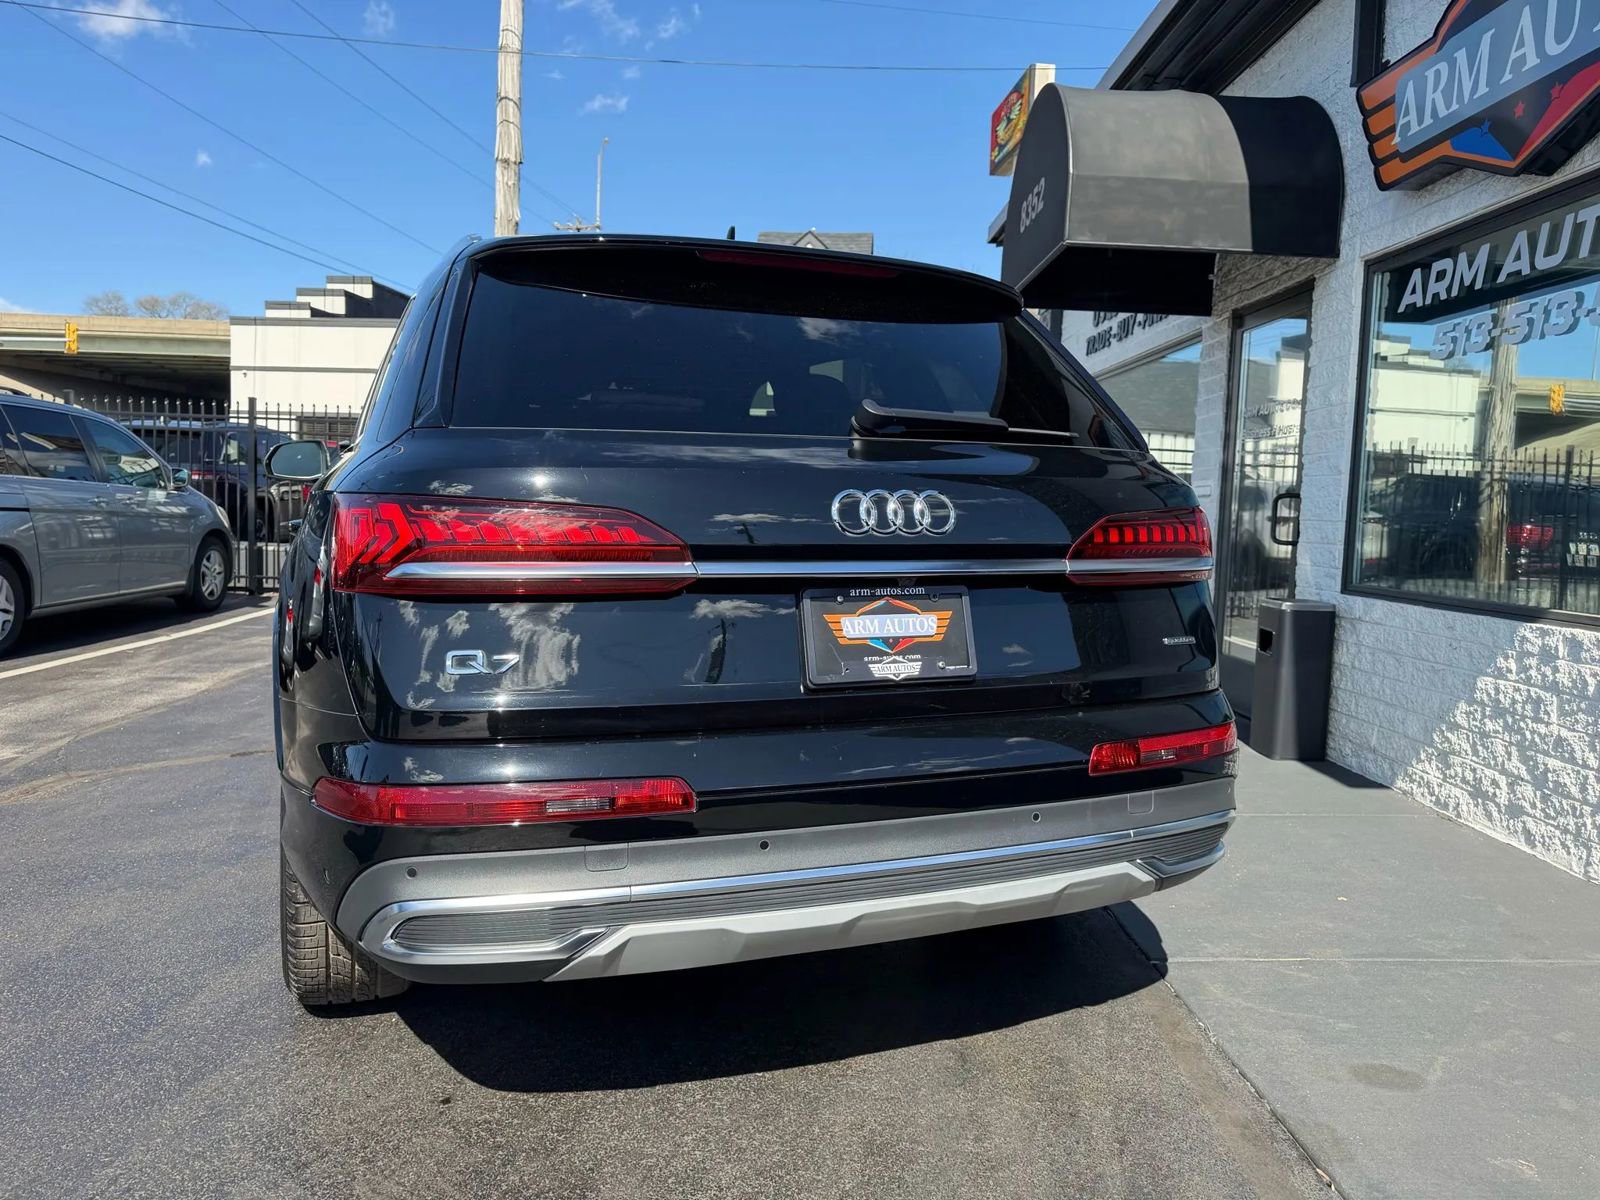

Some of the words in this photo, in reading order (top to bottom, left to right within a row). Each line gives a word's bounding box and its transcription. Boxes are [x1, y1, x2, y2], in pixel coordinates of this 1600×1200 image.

[1391, 27, 1495, 145] ARM
[1500, 0, 1600, 85] AU
[1020, 177, 1046, 233] 8352
[1397, 243, 1490, 313] ARM
[850, 587, 926, 597] arm-autos.com
[843, 619, 880, 636] ARM
[884, 616, 937, 634] AUTOS
[446, 649, 520, 675] Q7
